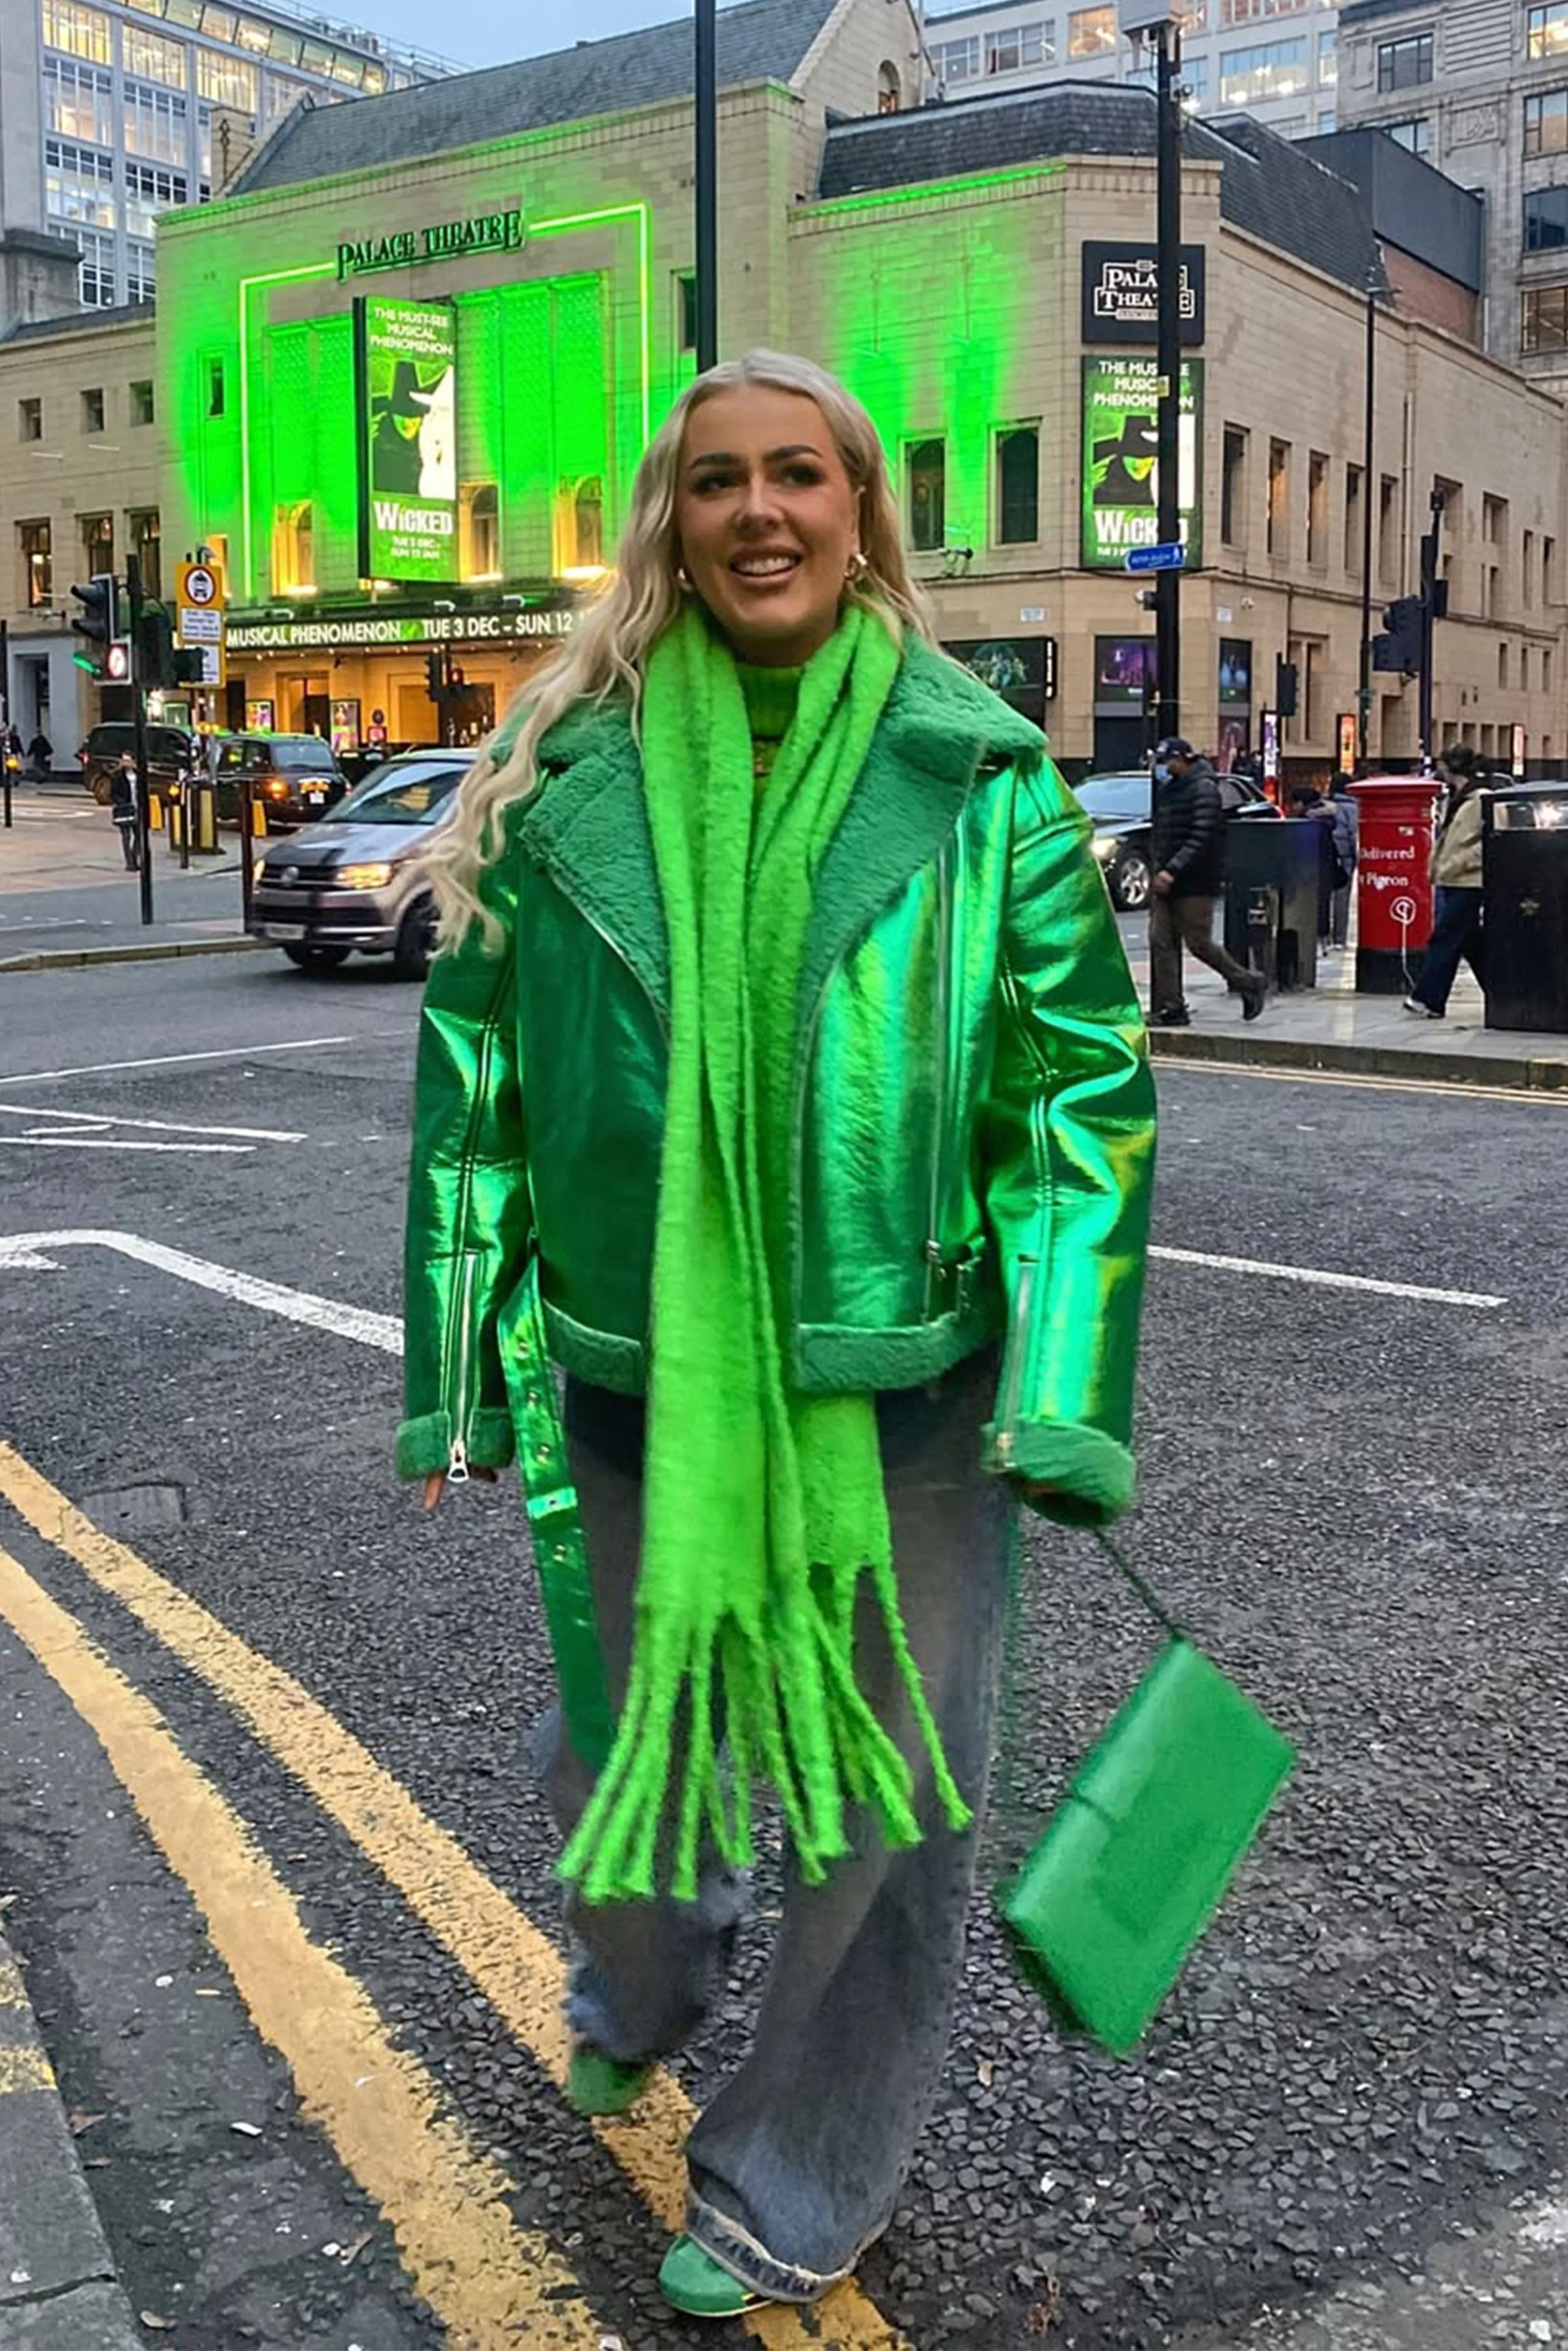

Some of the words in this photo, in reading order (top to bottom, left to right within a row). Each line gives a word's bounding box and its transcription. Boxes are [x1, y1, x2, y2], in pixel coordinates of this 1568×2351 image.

[337, 232, 416, 284] PALACE
[420, 209, 525, 250] THEATRE
[1100, 290, 1190, 311] THEAE
[375, 307, 396, 320] THE
[386, 323, 437, 340] MUSICAL
[370, 335, 454, 355] PHENOMENON
[1099, 361, 1125, 374] THE
[1114, 377, 1159, 391] MUSIC
[226, 625, 288, 647] MUSICAL
[290, 616, 401, 643] PHENOMENON
[423, 619, 450, 638] TUE
[453, 619, 463, 637] 3
[468, 616, 500, 636] DEC
[516, 613, 551, 634] SUN
[556, 611, 573, 632] 12
